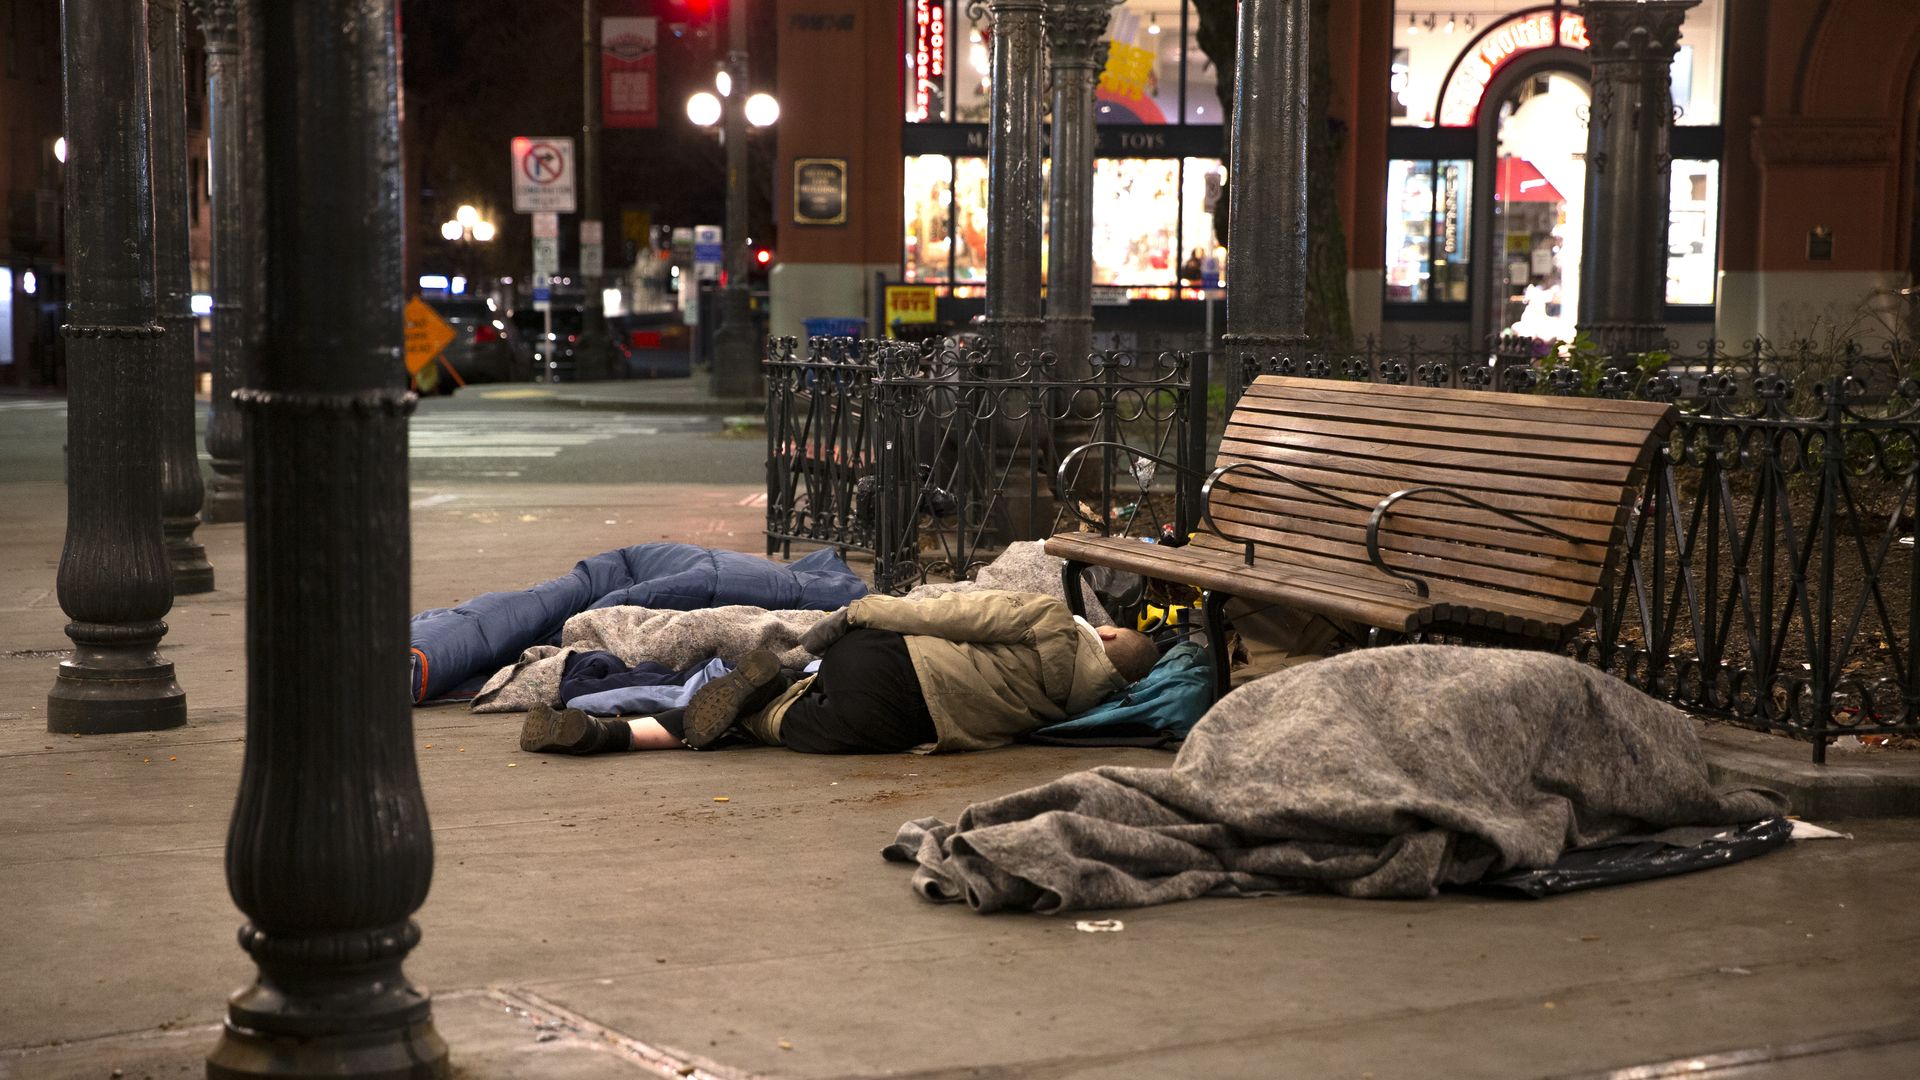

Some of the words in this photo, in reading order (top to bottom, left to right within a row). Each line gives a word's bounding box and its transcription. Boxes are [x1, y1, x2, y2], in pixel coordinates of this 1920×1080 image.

[931, 6, 943, 75] BOOKS
[1481, 16, 1552, 65] MOUSE
[1121, 132, 1166, 148] TOYS
